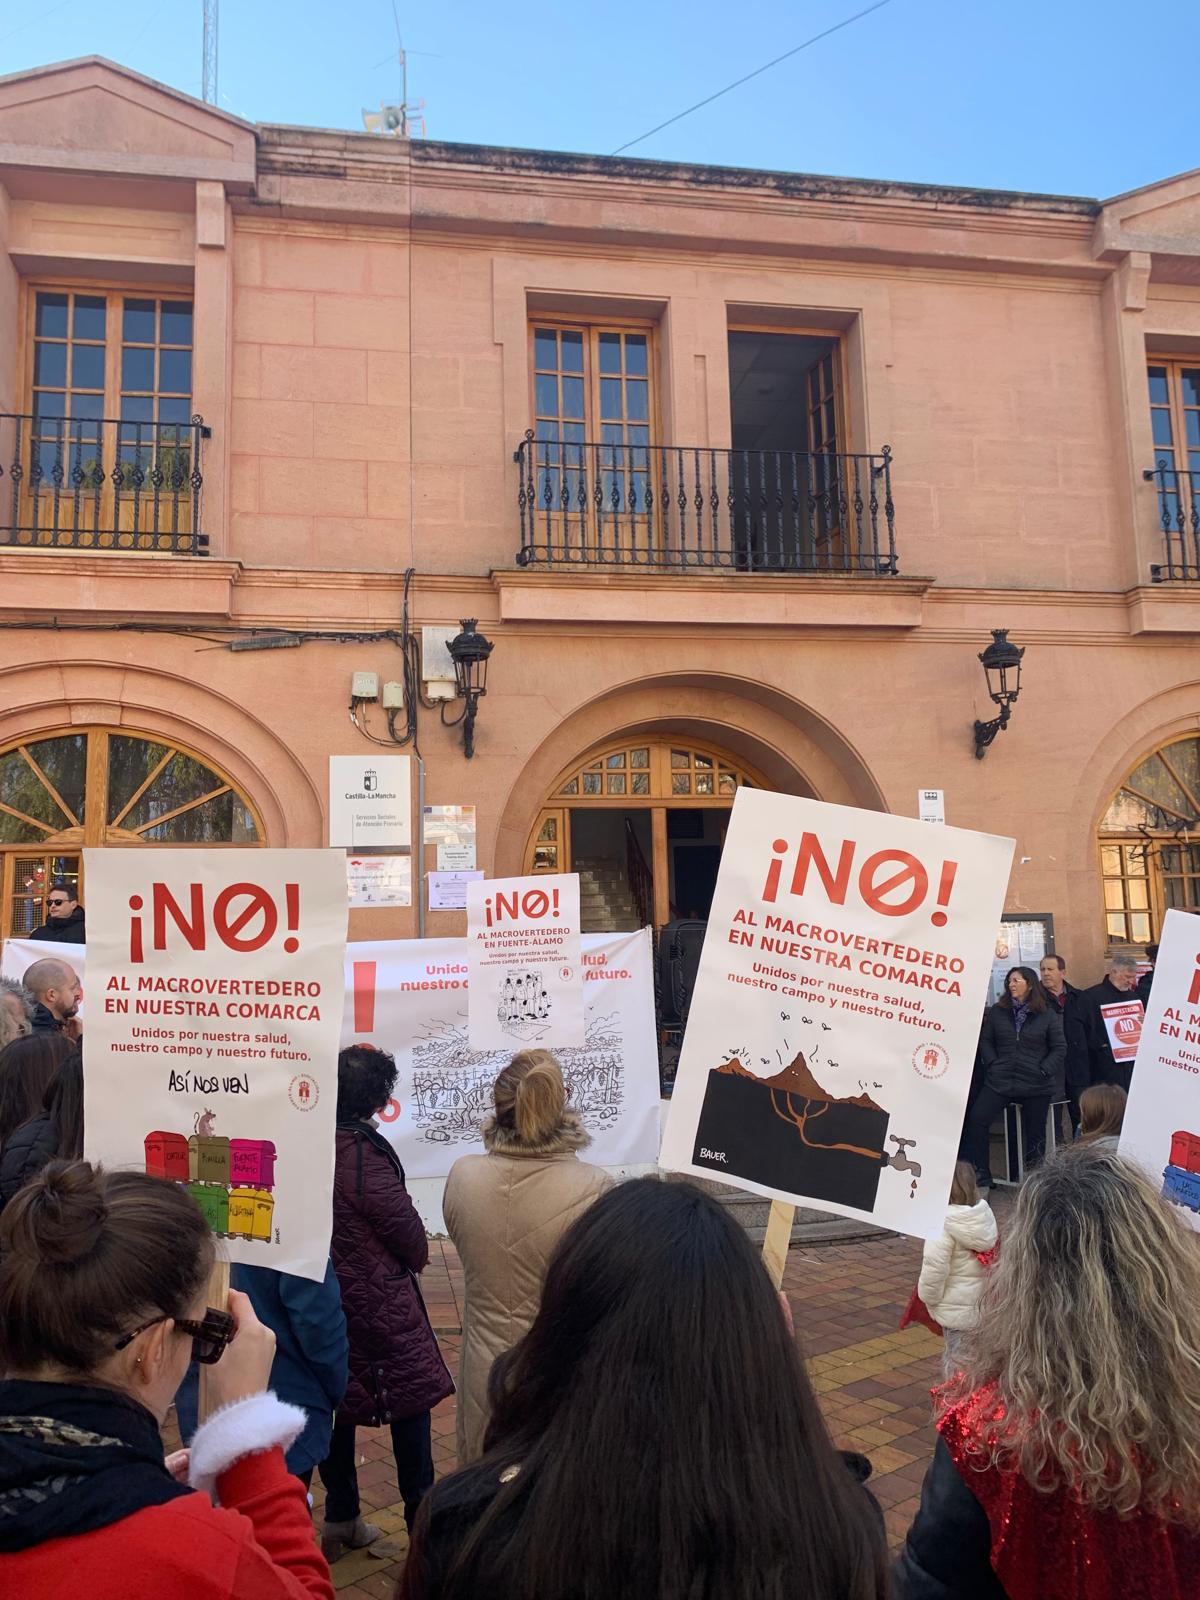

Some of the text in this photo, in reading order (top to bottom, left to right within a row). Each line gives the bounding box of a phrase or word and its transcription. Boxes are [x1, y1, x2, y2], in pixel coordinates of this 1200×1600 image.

[762, 831, 958, 927] ¡NO!
[484, 888, 560, 927] ¡NO!
[129, 882, 299, 963] ¡NO!
[490, 928, 570, 939] MACROVERTEDERO
[732, 909, 757, 926] AL
[764, 917, 965, 975] MACROVERTEDERO
[581, 953, 608, 966] lud,
[728, 929, 962, 997] EN NUESTRA COMARCA
[400, 979, 460, 991] nuestro
[586, 969, 632, 981] futuro.
[106, 976, 321, 998] AL MACROVERTEDERO
[753, 961, 925, 1014] Unidos por nuestra salud,
[105, 998, 321, 1021] EN NUESTRA COMARCA
[728, 972, 945, 1033] nuestro campo y nuestro futuro.
[1120, 1018, 1135, 1032] NO
[1164, 1008, 1183, 1022] AL
[132, 1027, 292, 1046] Unidos por nuestra salud,
[1160, 1022, 1180, 1038] EN
[111, 1042, 312, 1061] nuestro campo y nuestro futuro.
[1158, 1056, 1199, 1074] nuestro
[168, 1070, 250, 1094] ASÍ NOS VEN
